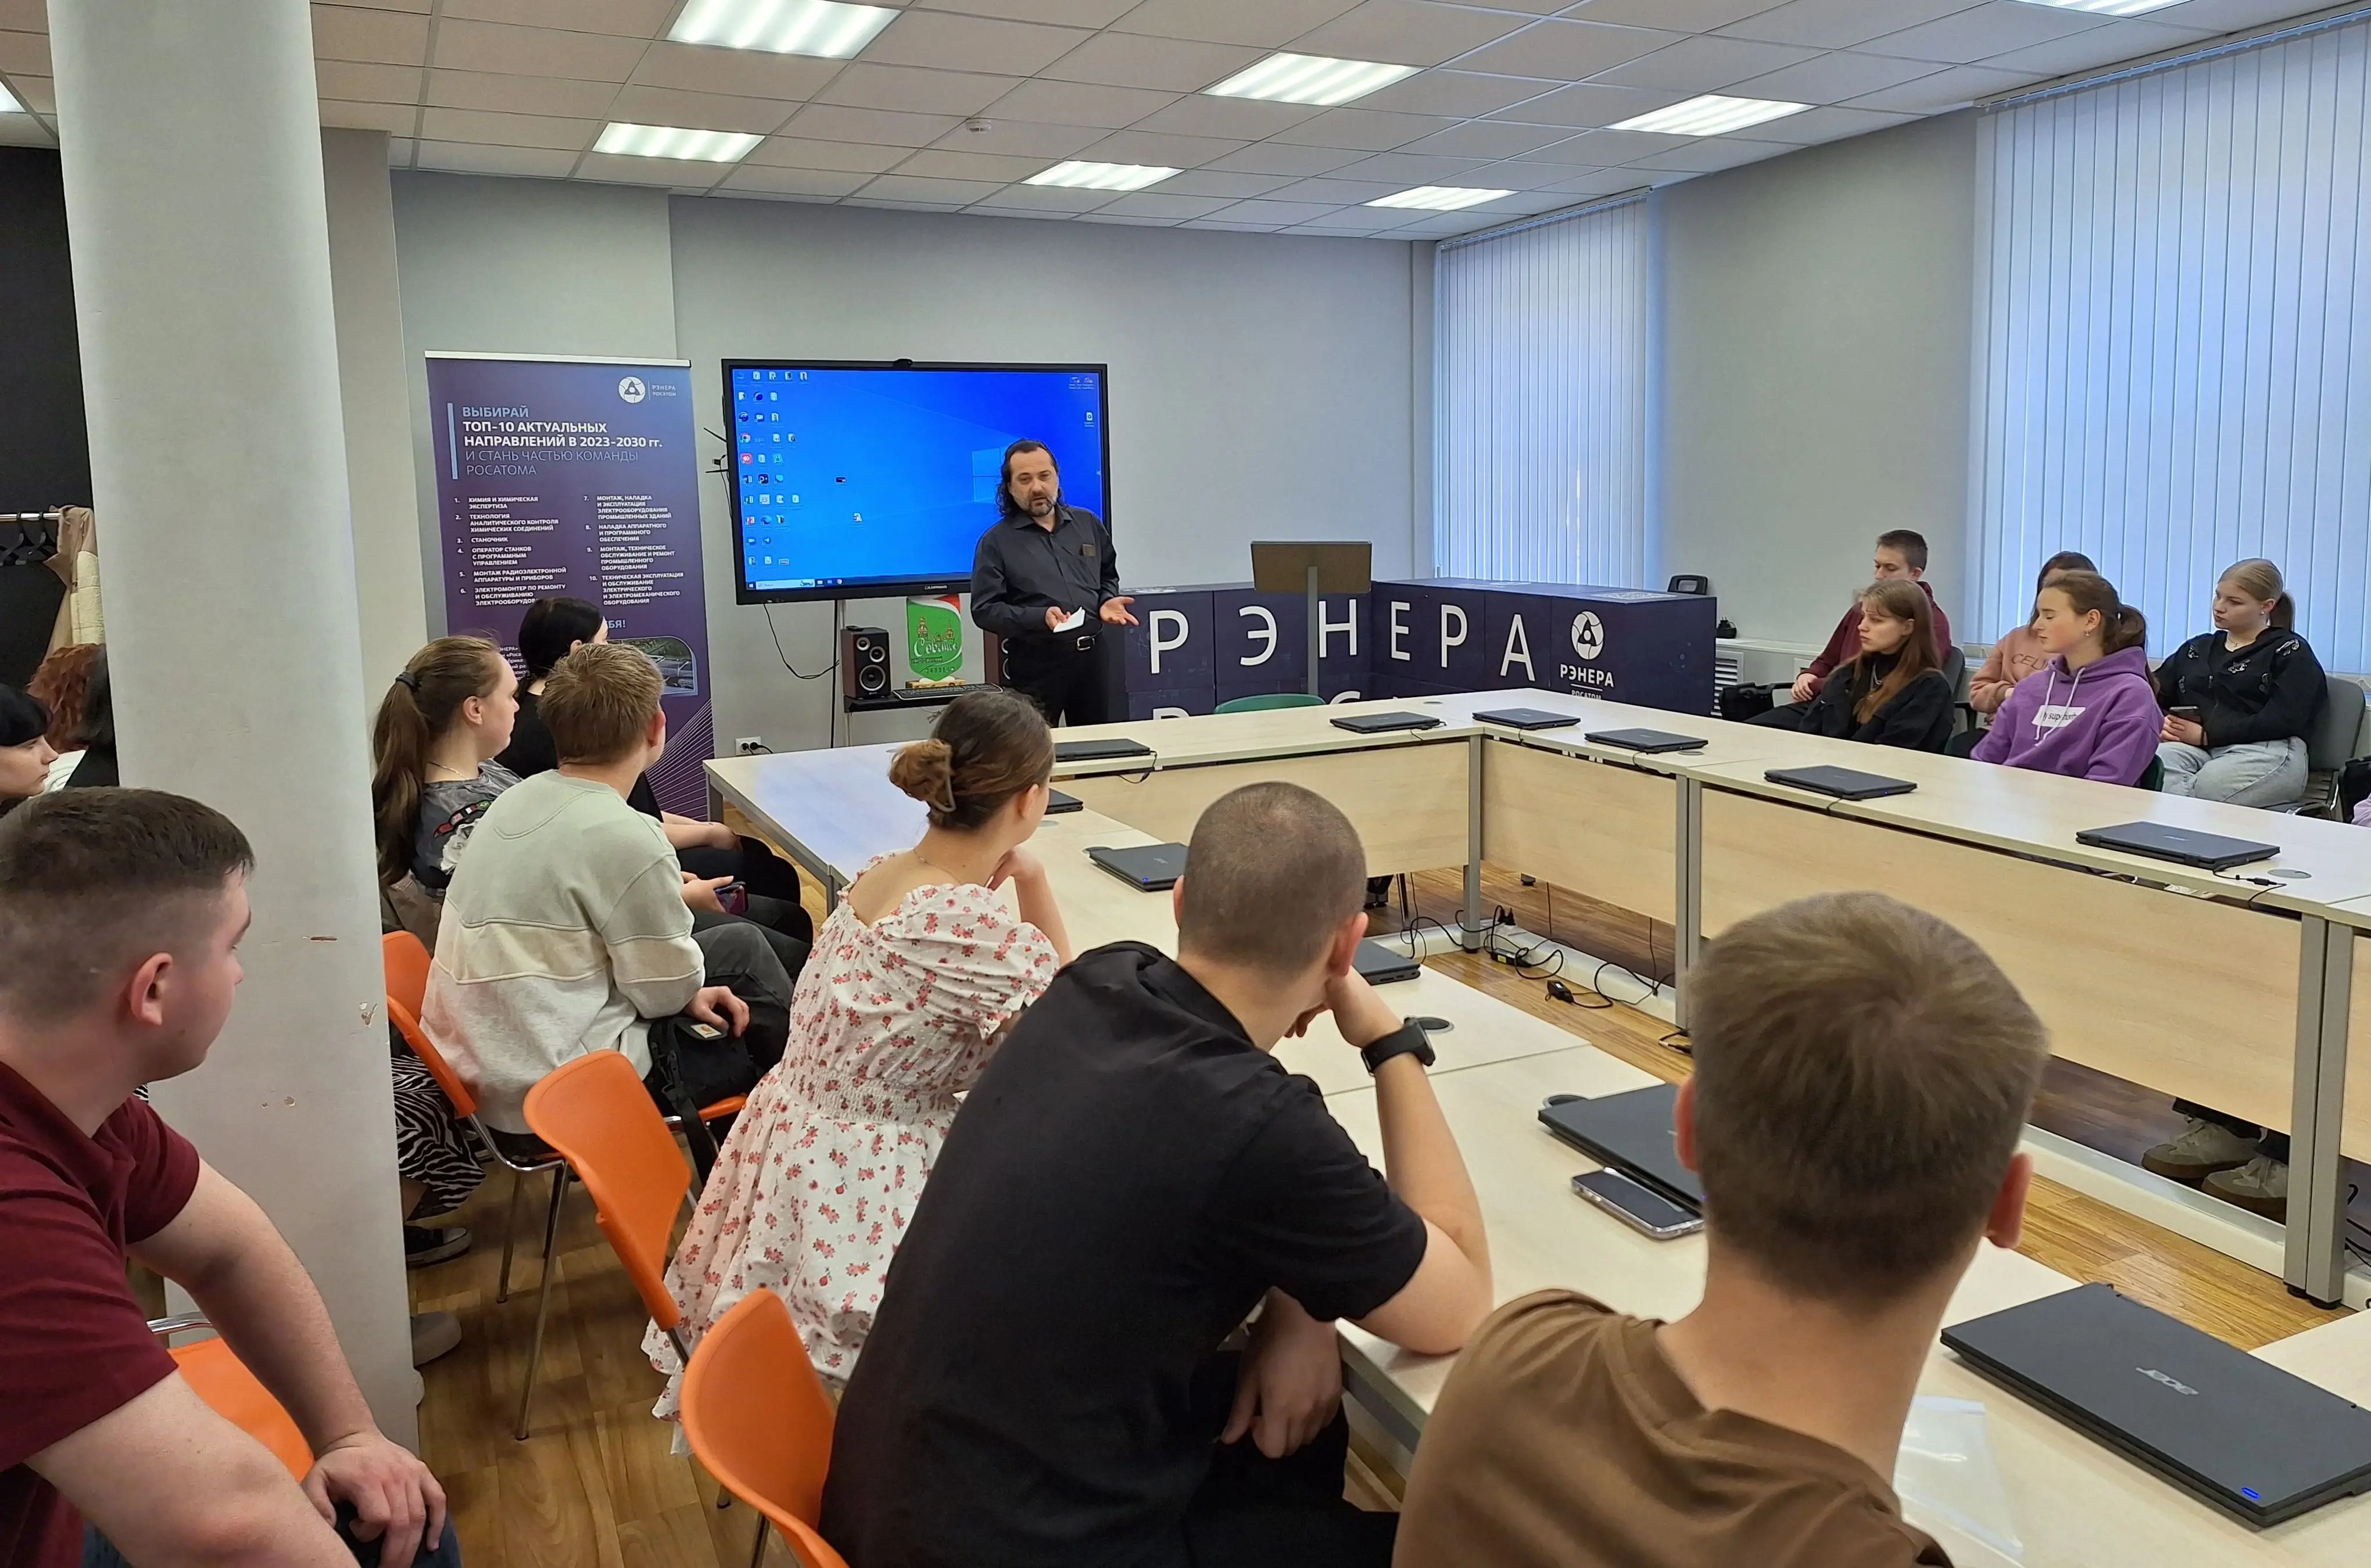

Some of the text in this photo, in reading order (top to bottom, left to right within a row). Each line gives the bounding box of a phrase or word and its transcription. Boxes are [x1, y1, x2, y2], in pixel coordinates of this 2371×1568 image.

[463, 406, 529, 418] ВЫБИРАЙ
[463, 421, 608, 433] ТОП-10 АКТУАЛЬНЫХ
[464, 434, 663, 448] НАПРАВЛЕНИЙ В 2023-2030 гг.
[465, 451, 639, 463] И СТАНЬ ЧАСТЬЮ КОМАНДЫ
[467, 465, 538, 476] РОСАТОМА
[502, 567, 567, 575] РАДИОЭЛЕКТРОННОЙ
[608, 591, 680, 599] ЭЛЕКТРОМЕХАНИЧЕСКОГО
[476, 598, 538, 607] ЭЛЕКТРООБОРУДОВ
[607, 619, 626, 628] БЯ!
[1560, 664, 1614, 688] РЭНЕРА
